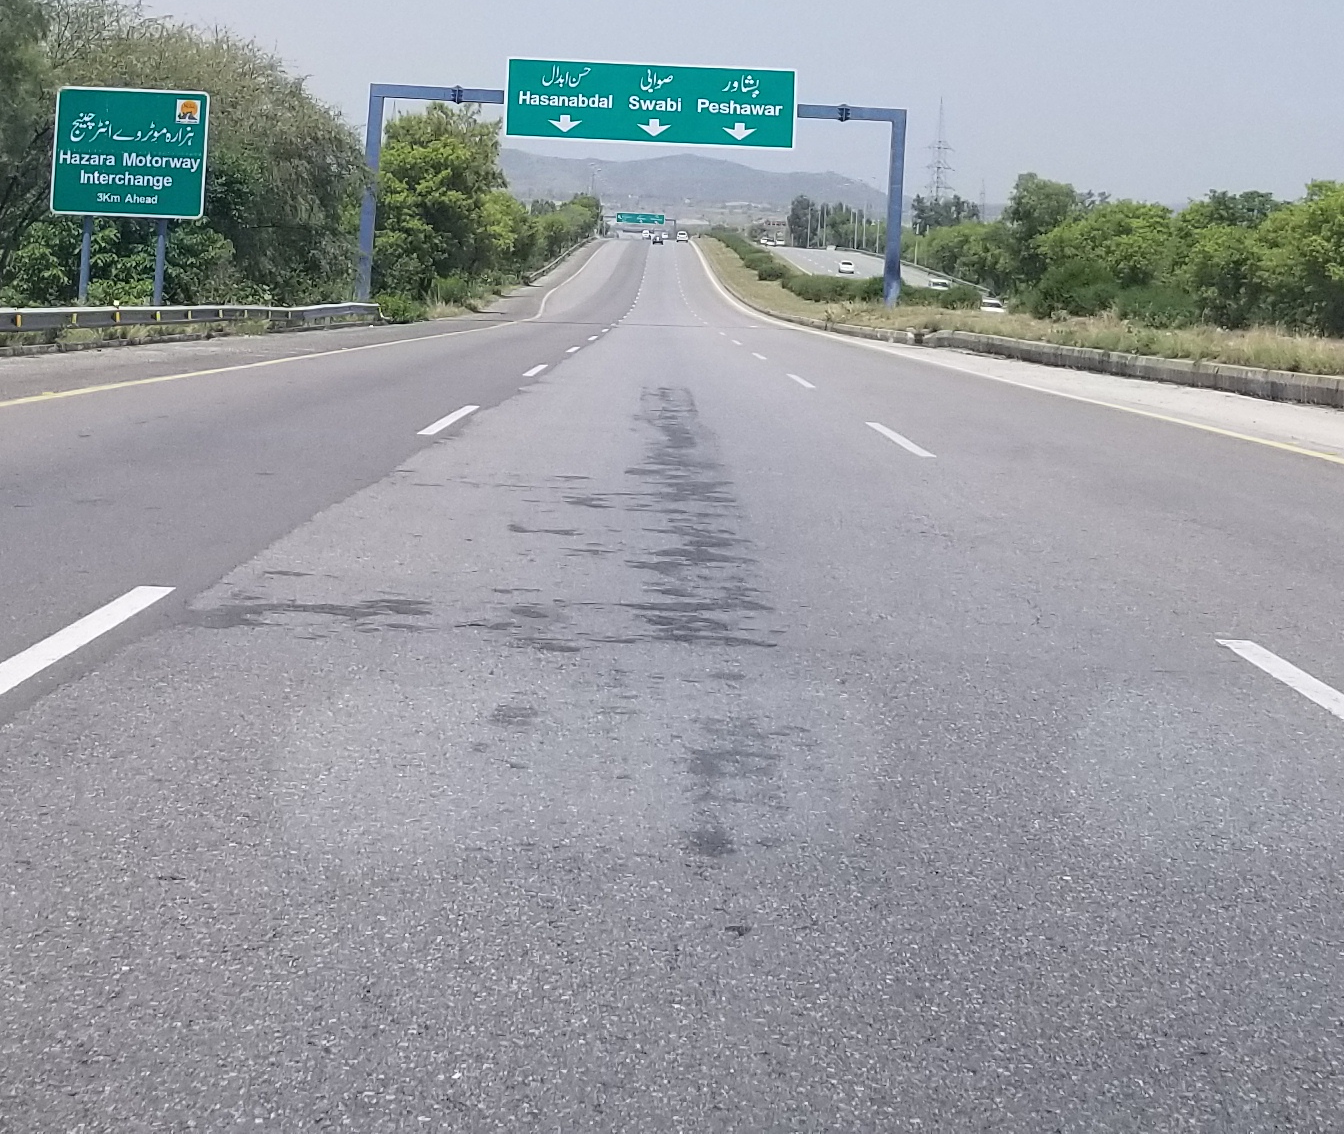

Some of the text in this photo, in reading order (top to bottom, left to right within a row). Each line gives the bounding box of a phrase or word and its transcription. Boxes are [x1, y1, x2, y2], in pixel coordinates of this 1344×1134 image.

[721, 74, 760, 98] پشاور
[518, 90, 613, 109] Hasanabdal
[628, 95, 682, 112] Swabi
[697, 98, 783, 116] Peshawar
[59, 149, 201, 173] Hazara Motorway
[80, 170, 173, 190] Interchange
[96, 192, 158, 204] 3Km Ahead
